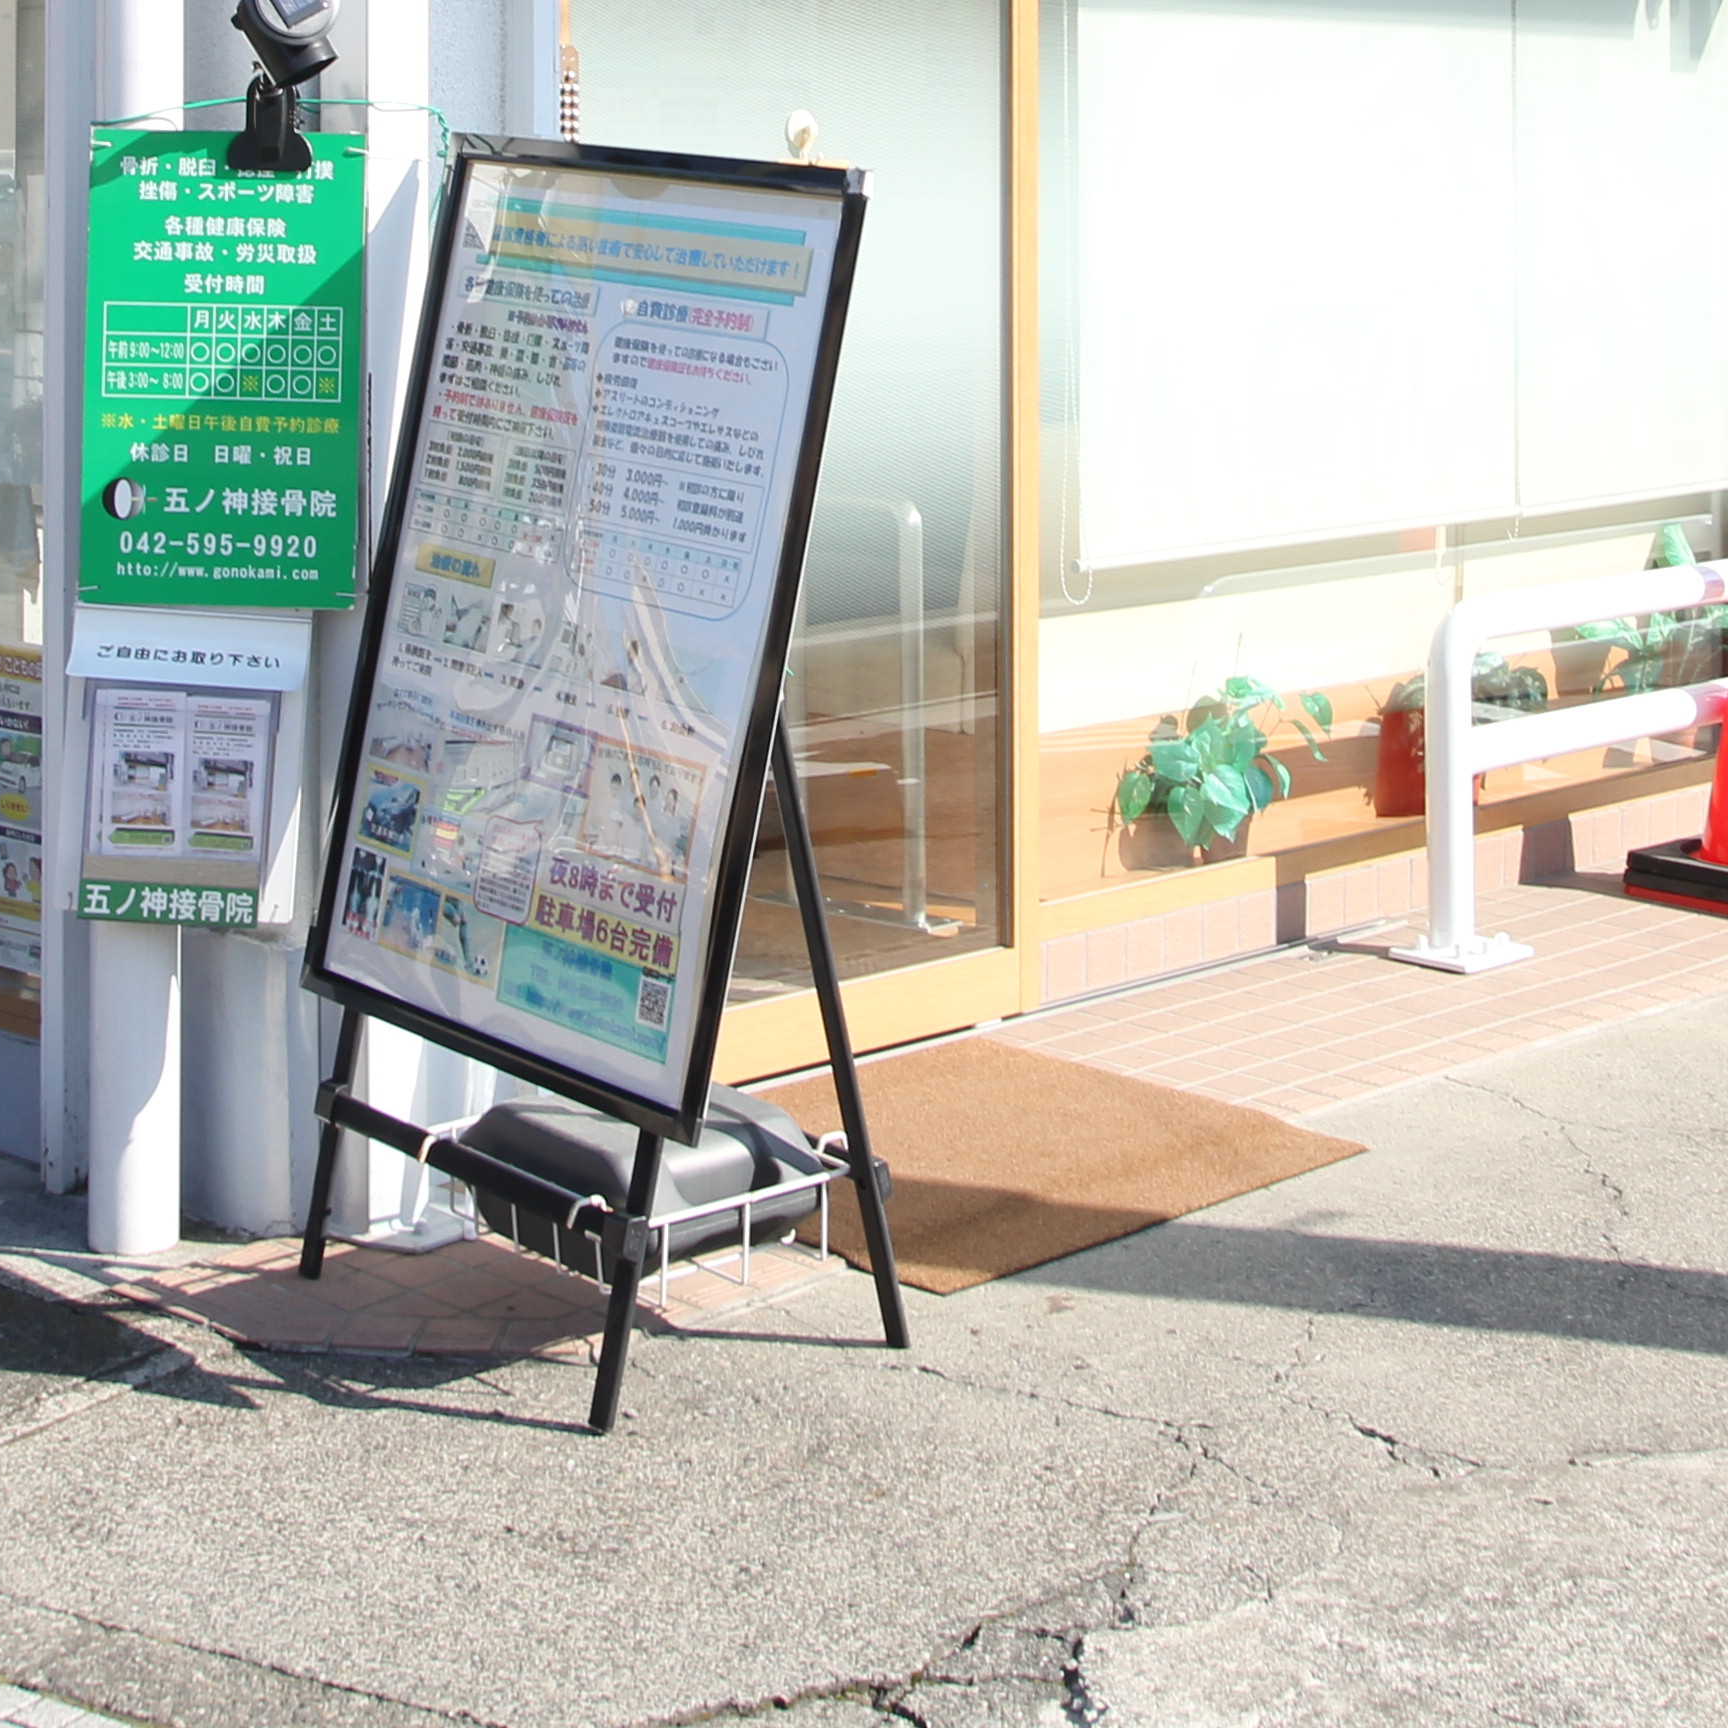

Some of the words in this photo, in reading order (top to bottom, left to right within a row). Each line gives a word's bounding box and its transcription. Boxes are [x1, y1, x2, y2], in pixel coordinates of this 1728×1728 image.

[138, 180, 315, 205] 挫傷・スポーツ障害
[164, 216, 288, 238] 各種健康保険
[133, 240, 318, 265] 交通事故・労災取扱
[184, 274, 265, 295] 受付時間
[194, 311, 210, 330] 月
[218, 312, 235, 330] 火
[243, 313, 262, 331] 水
[268, 313, 286, 331] 木
[293, 312, 313, 332] 金
[319, 314, 337, 332] 土
[130, 442, 189, 464] 休診日
[214, 445, 313, 466] 日曜・祝日
[163, 487, 337, 518] 五ノ神接骨院
[119, 530, 318, 559] 042-595-9920
[97, 644, 281, 669] ご自由にお取り下さい
[548, 854, 678, 923] 夜8時まで受付
[83, 883, 254, 924] 五ノ神接骨院
[534, 893, 674, 969] 駐車場6台完備
